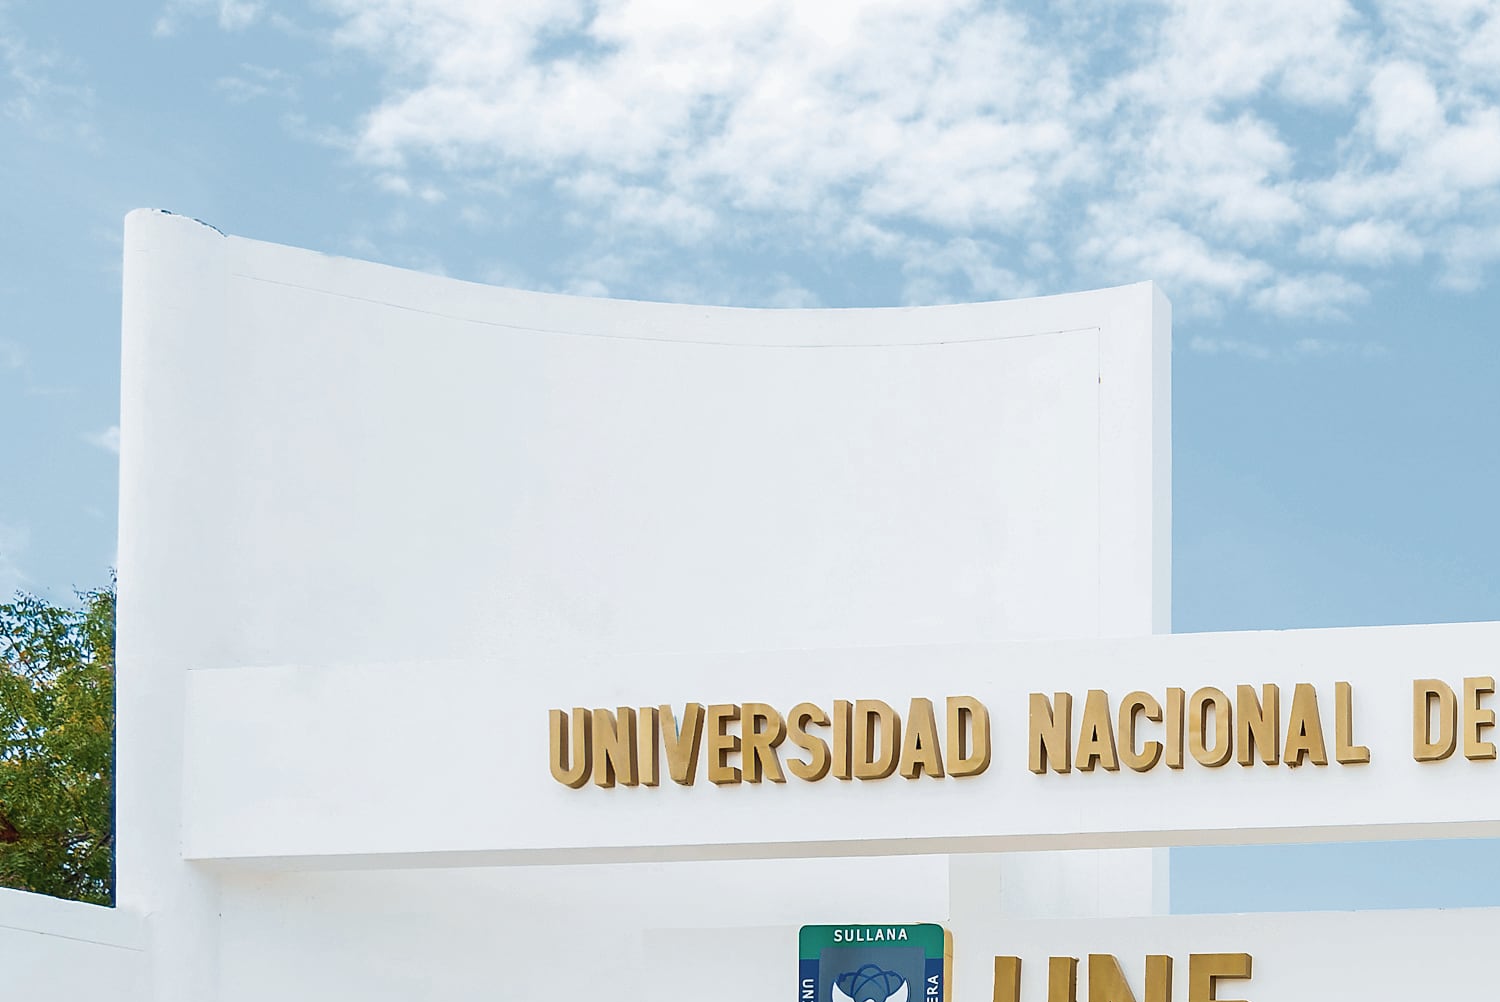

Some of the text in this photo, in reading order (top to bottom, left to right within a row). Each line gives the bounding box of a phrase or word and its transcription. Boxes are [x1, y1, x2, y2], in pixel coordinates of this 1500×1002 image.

[548, 695, 991, 788] UNIVERSIDAD
[1029, 681, 1370, 774] NACIONAL
[1412, 676, 1497, 762] DE
[833, 928, 908, 942] SULLANA
